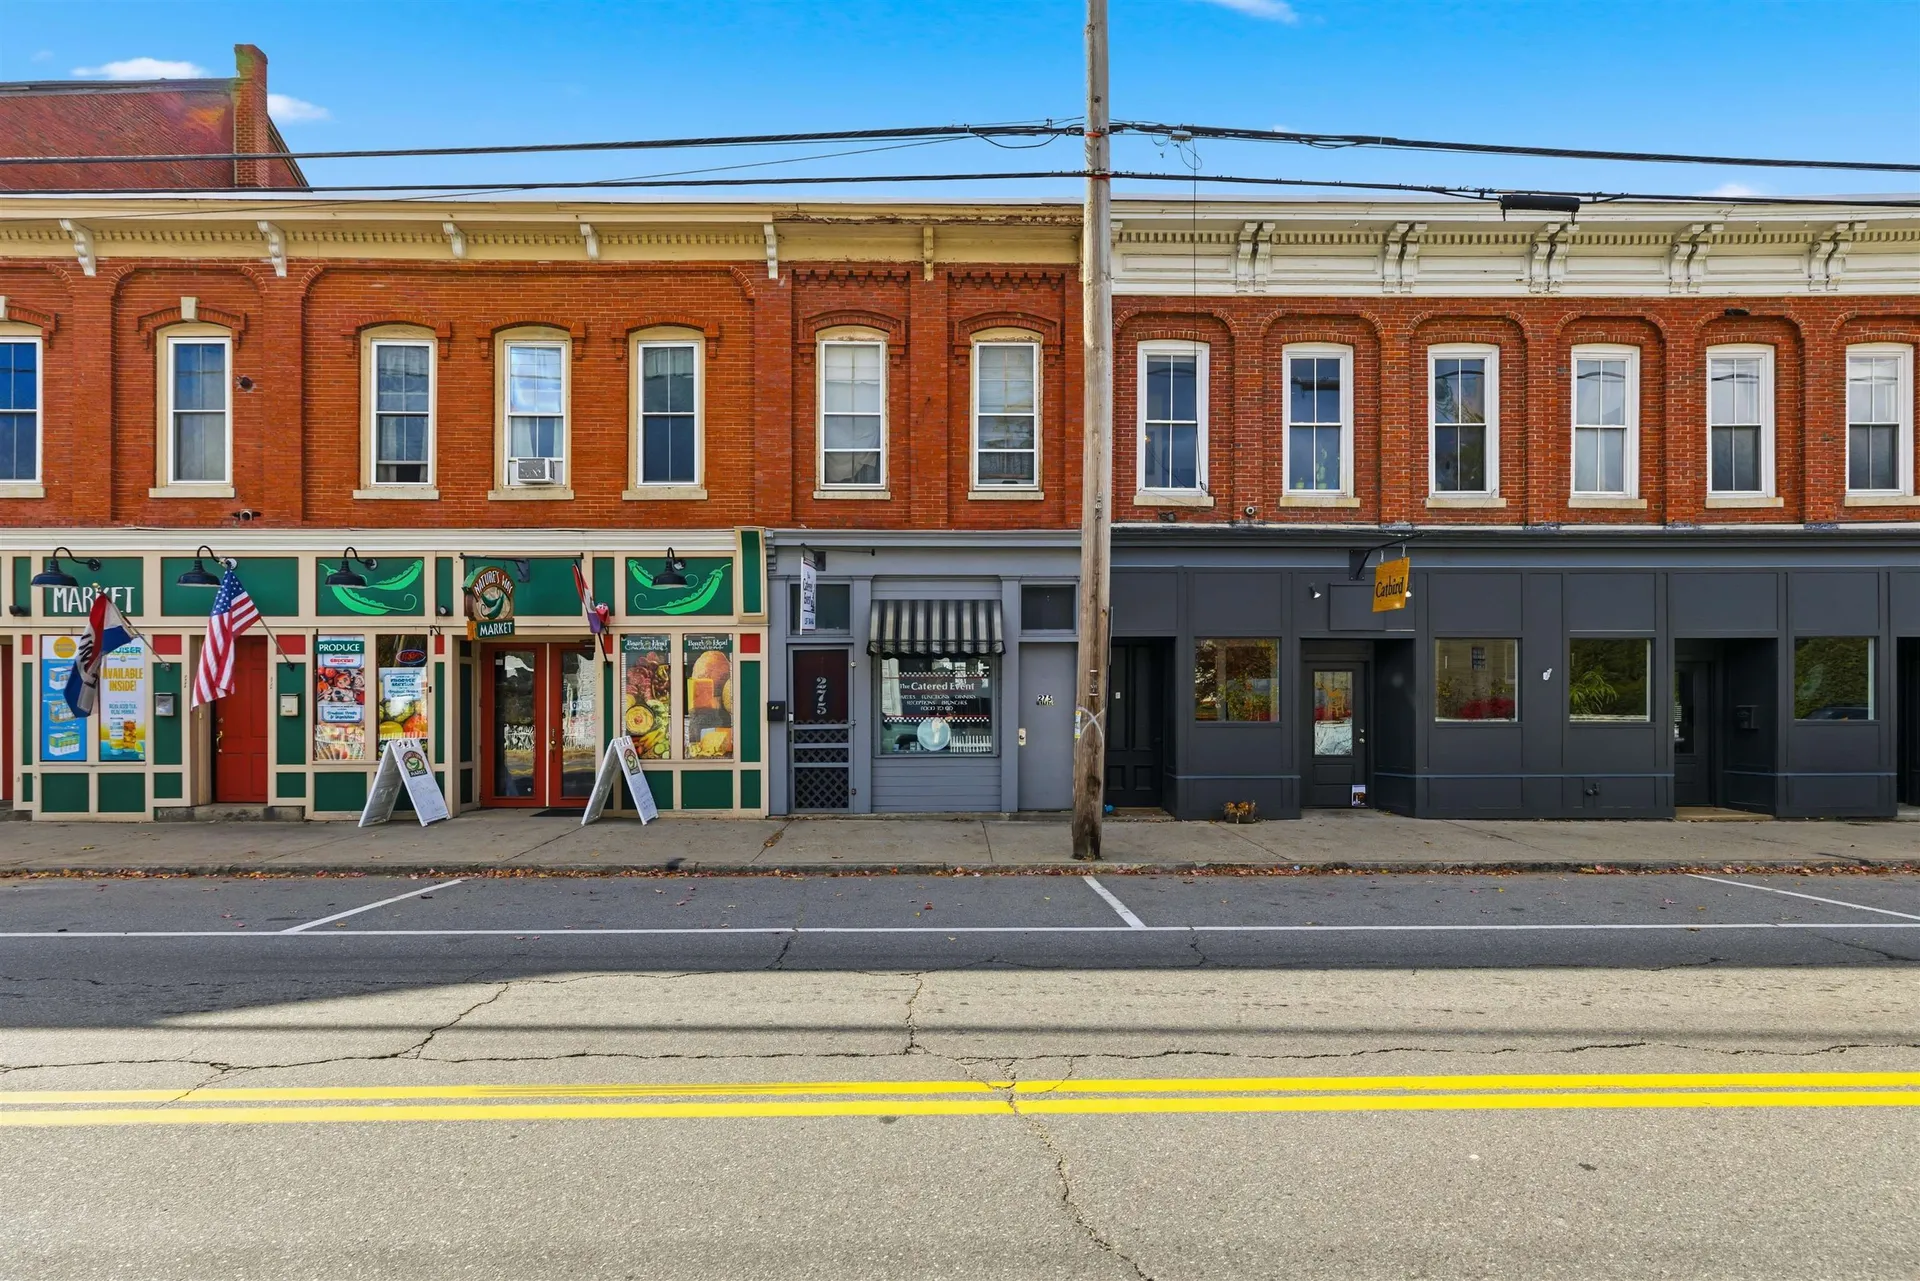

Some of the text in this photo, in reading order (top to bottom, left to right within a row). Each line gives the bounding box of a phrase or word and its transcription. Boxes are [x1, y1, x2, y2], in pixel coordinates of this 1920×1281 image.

[474, 570, 500, 596] NATURE'S
[1375, 575, 1405, 598] Catbird
[480, 622, 513, 636] MARKET
[318, 643, 361, 652] PRODUCE
[103, 667, 144, 679] AVAILABLE
[911, 681, 948, 691] Catered
[950, 681, 975, 691] Event
[816, 676, 827, 716] 275
